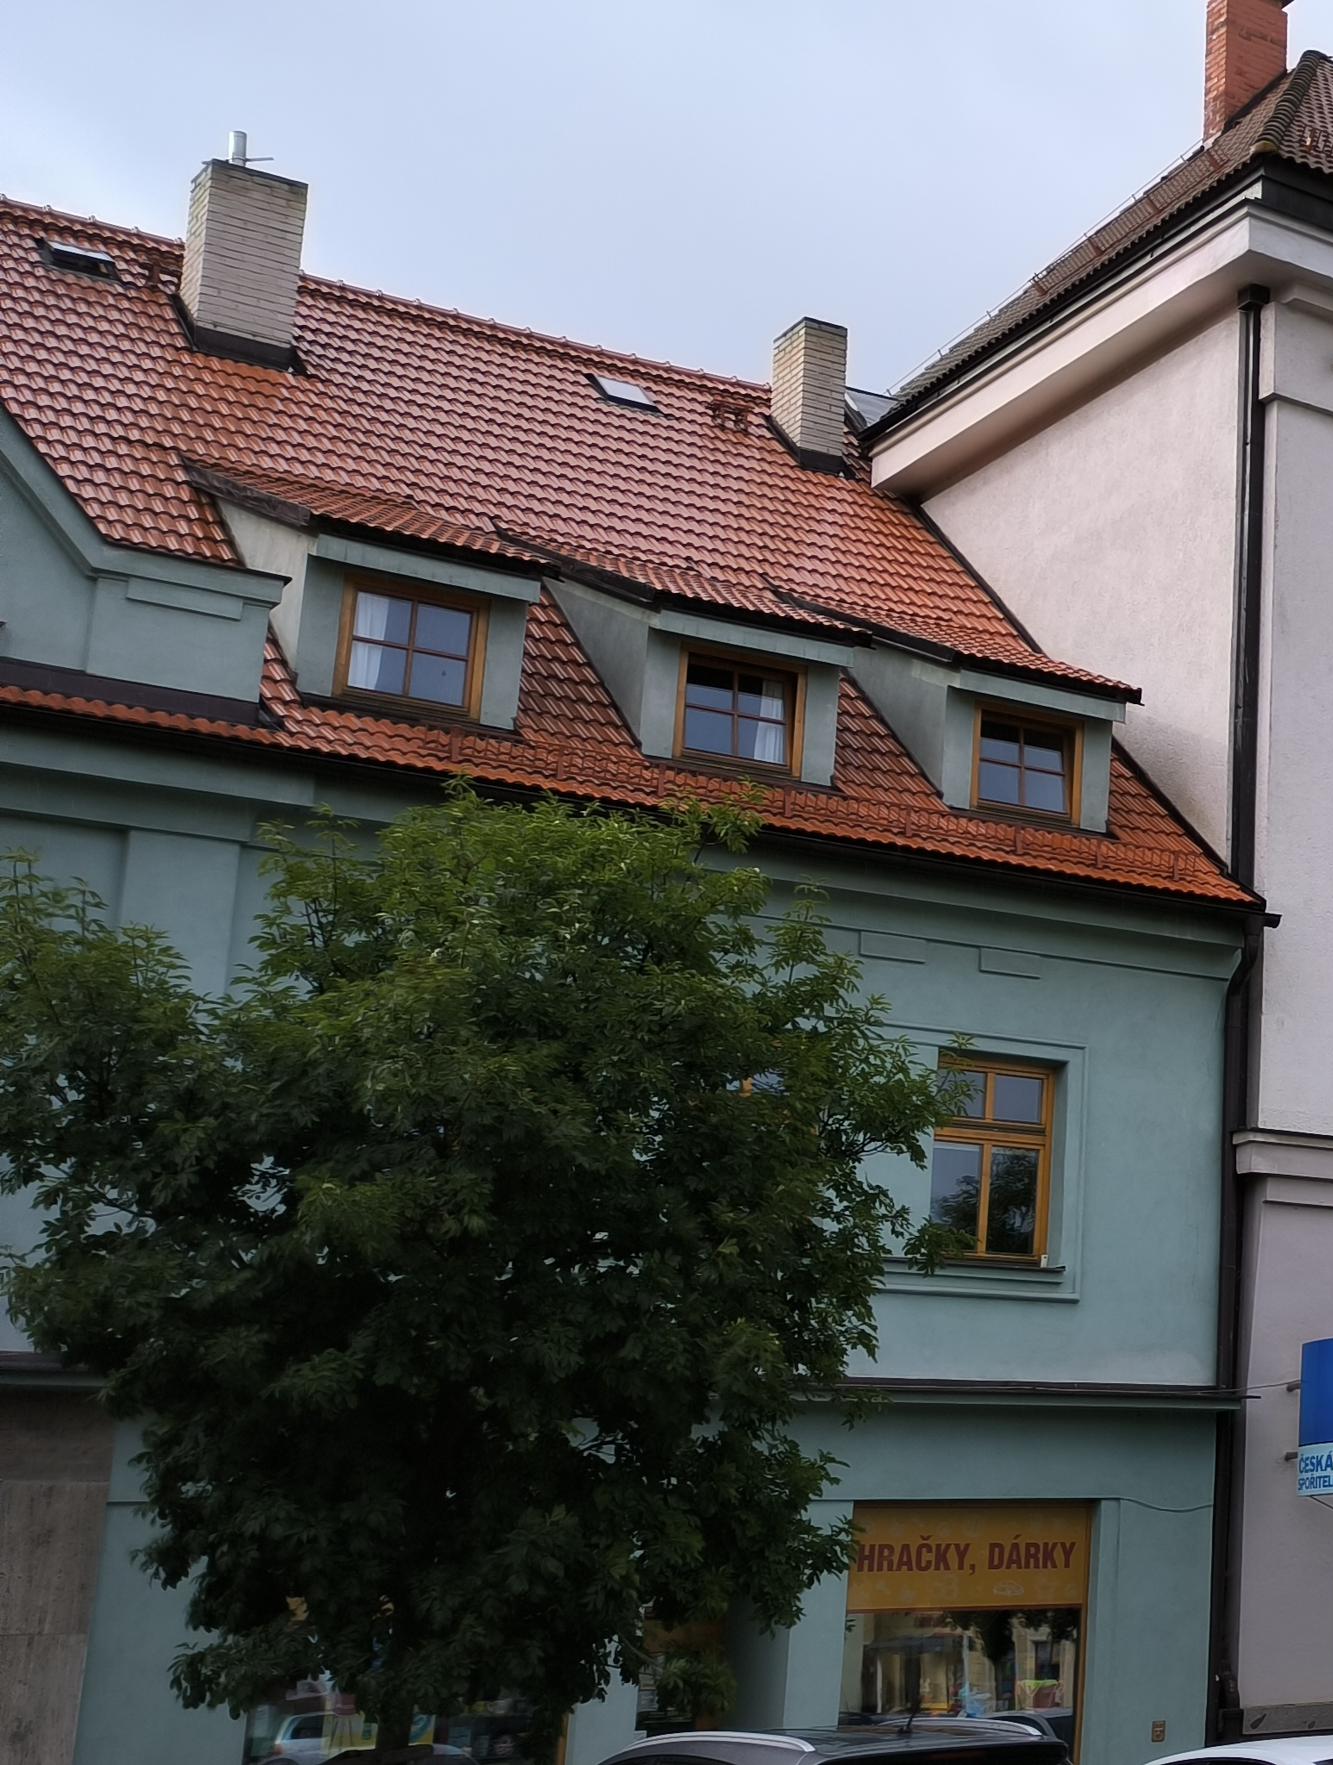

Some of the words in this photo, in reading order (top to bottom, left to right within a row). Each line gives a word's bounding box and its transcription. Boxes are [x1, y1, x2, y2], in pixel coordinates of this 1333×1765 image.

[1299, 1450, 1333, 1473] ČESKÁ
[857, 1535, 976, 1575] HRAČKY,
[987, 1534, 1077, 1570] DÁRKY
